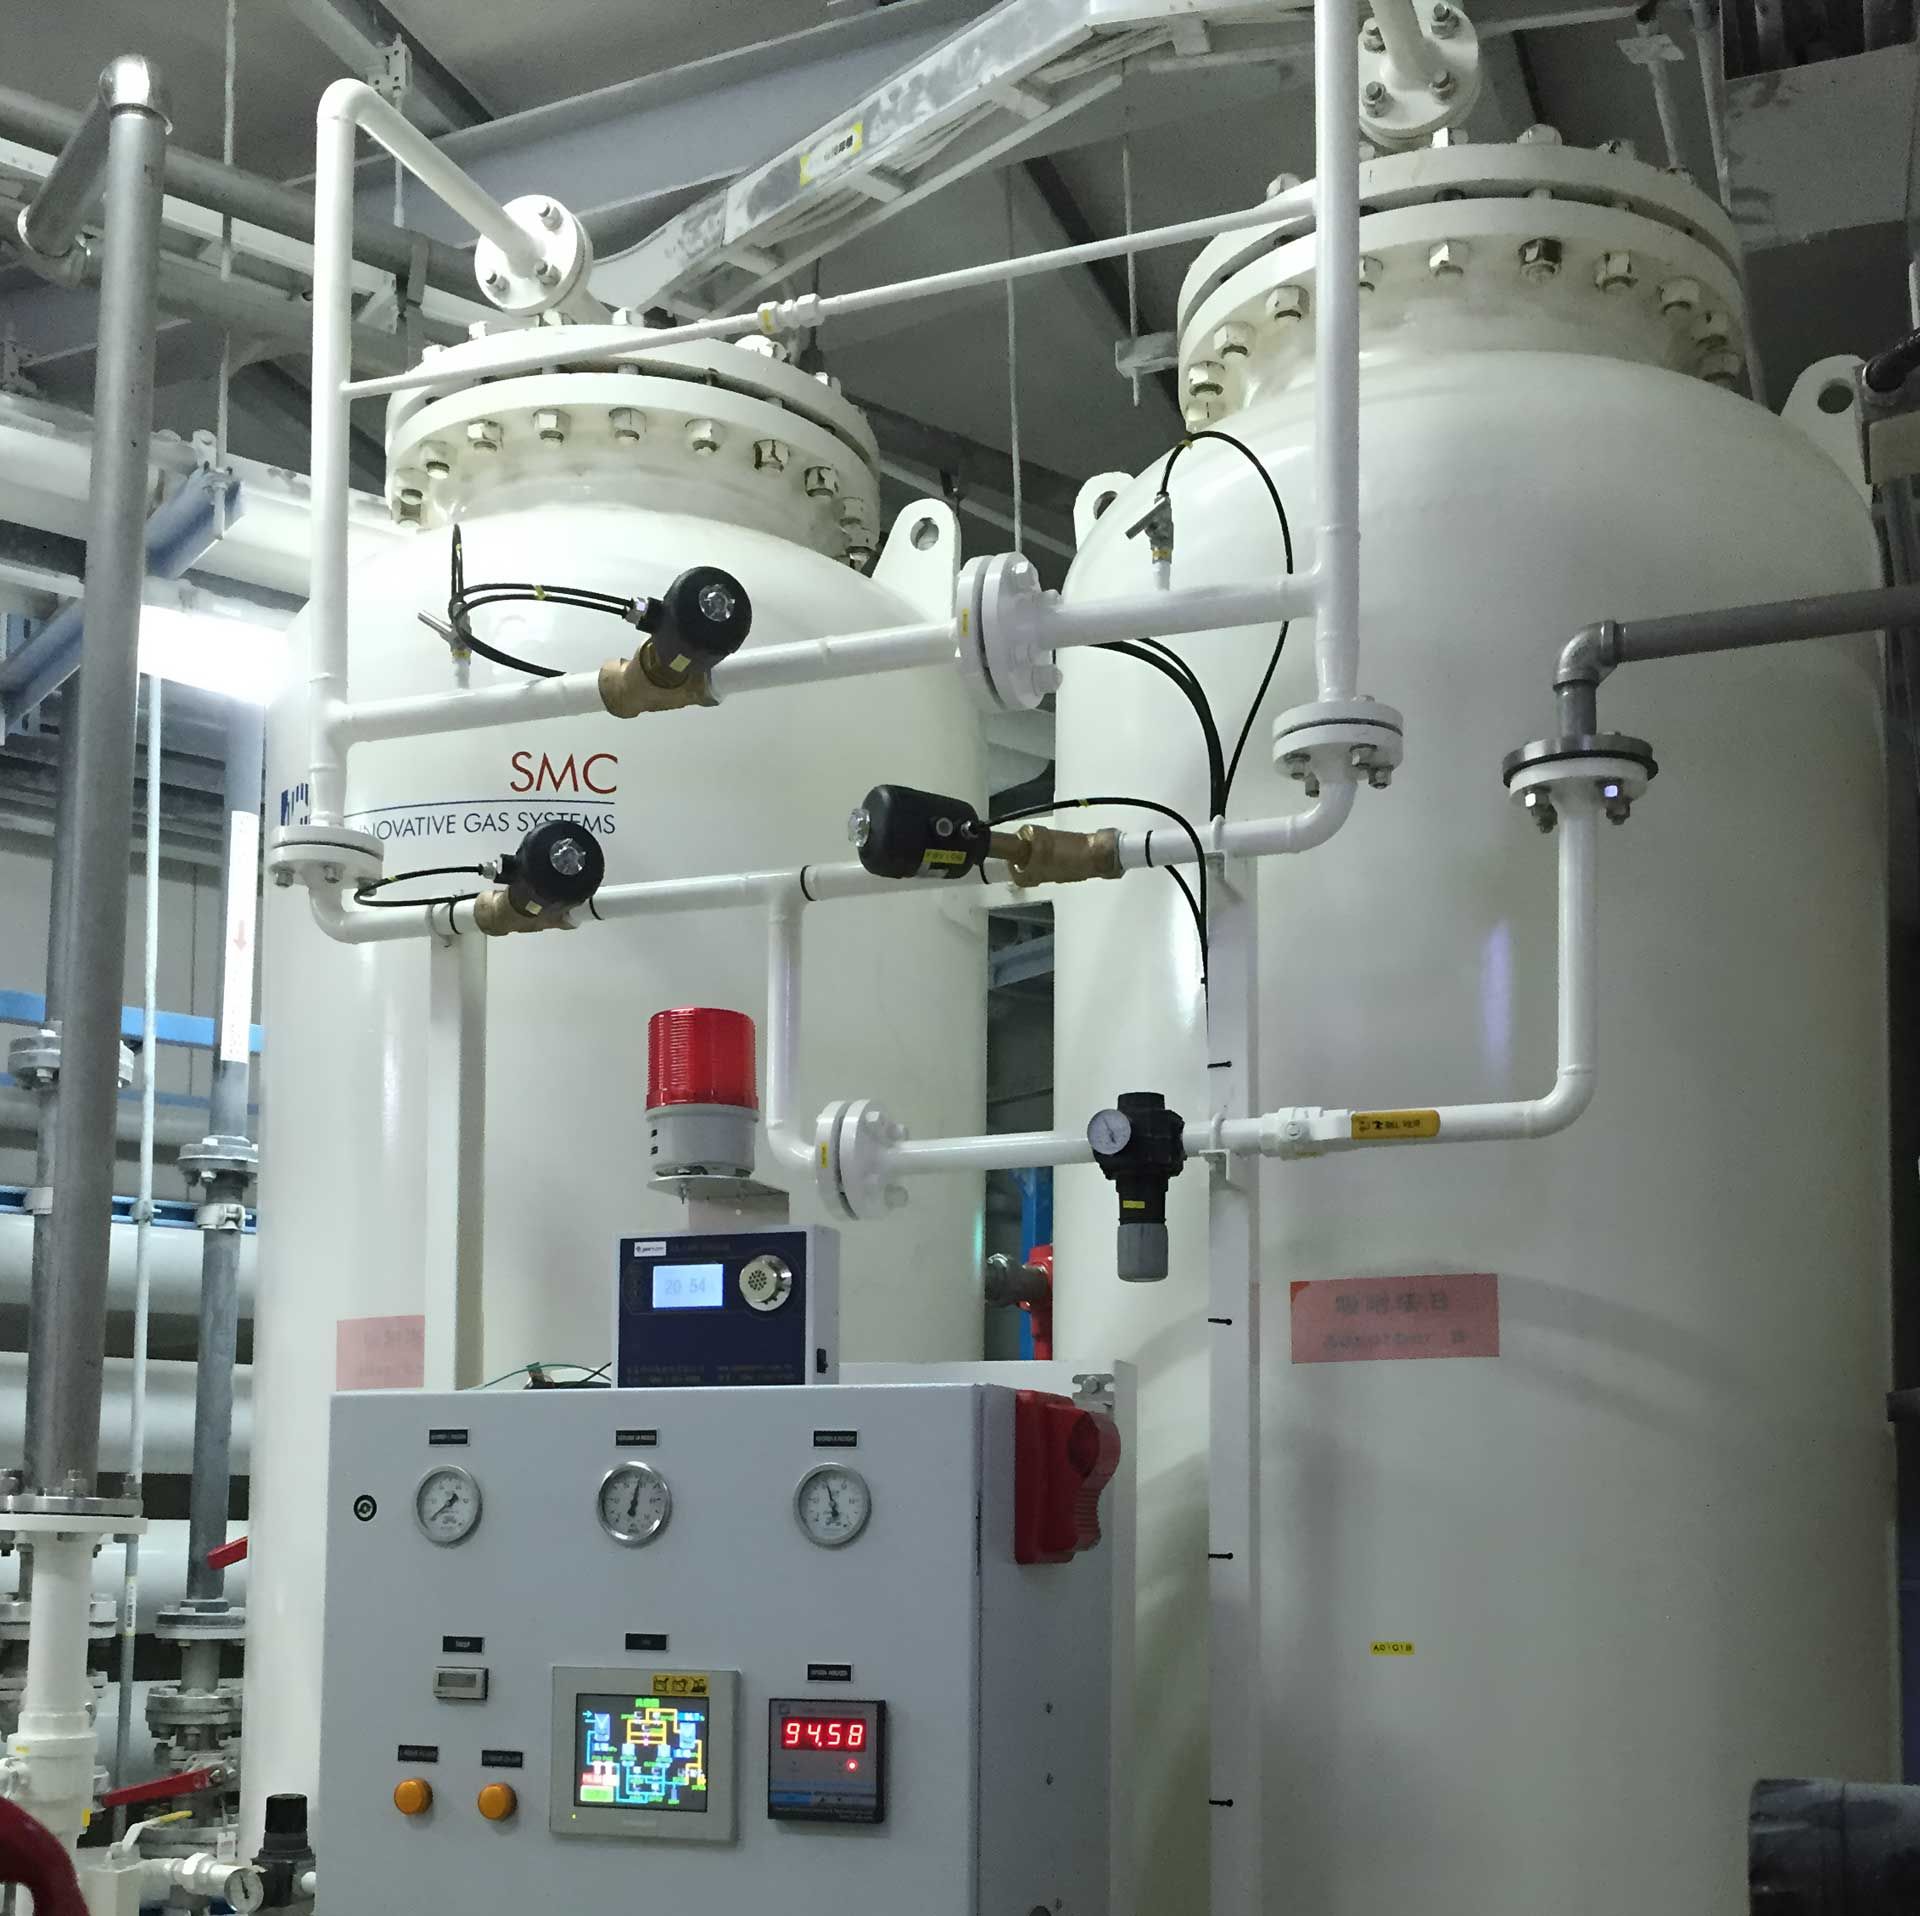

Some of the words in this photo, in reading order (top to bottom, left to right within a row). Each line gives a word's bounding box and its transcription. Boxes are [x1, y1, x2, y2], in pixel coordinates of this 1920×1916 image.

[510, 751, 618, 794] SMC
[464, 812, 510, 833] GAS
[785, 1722, 864, 1748] 94.58
